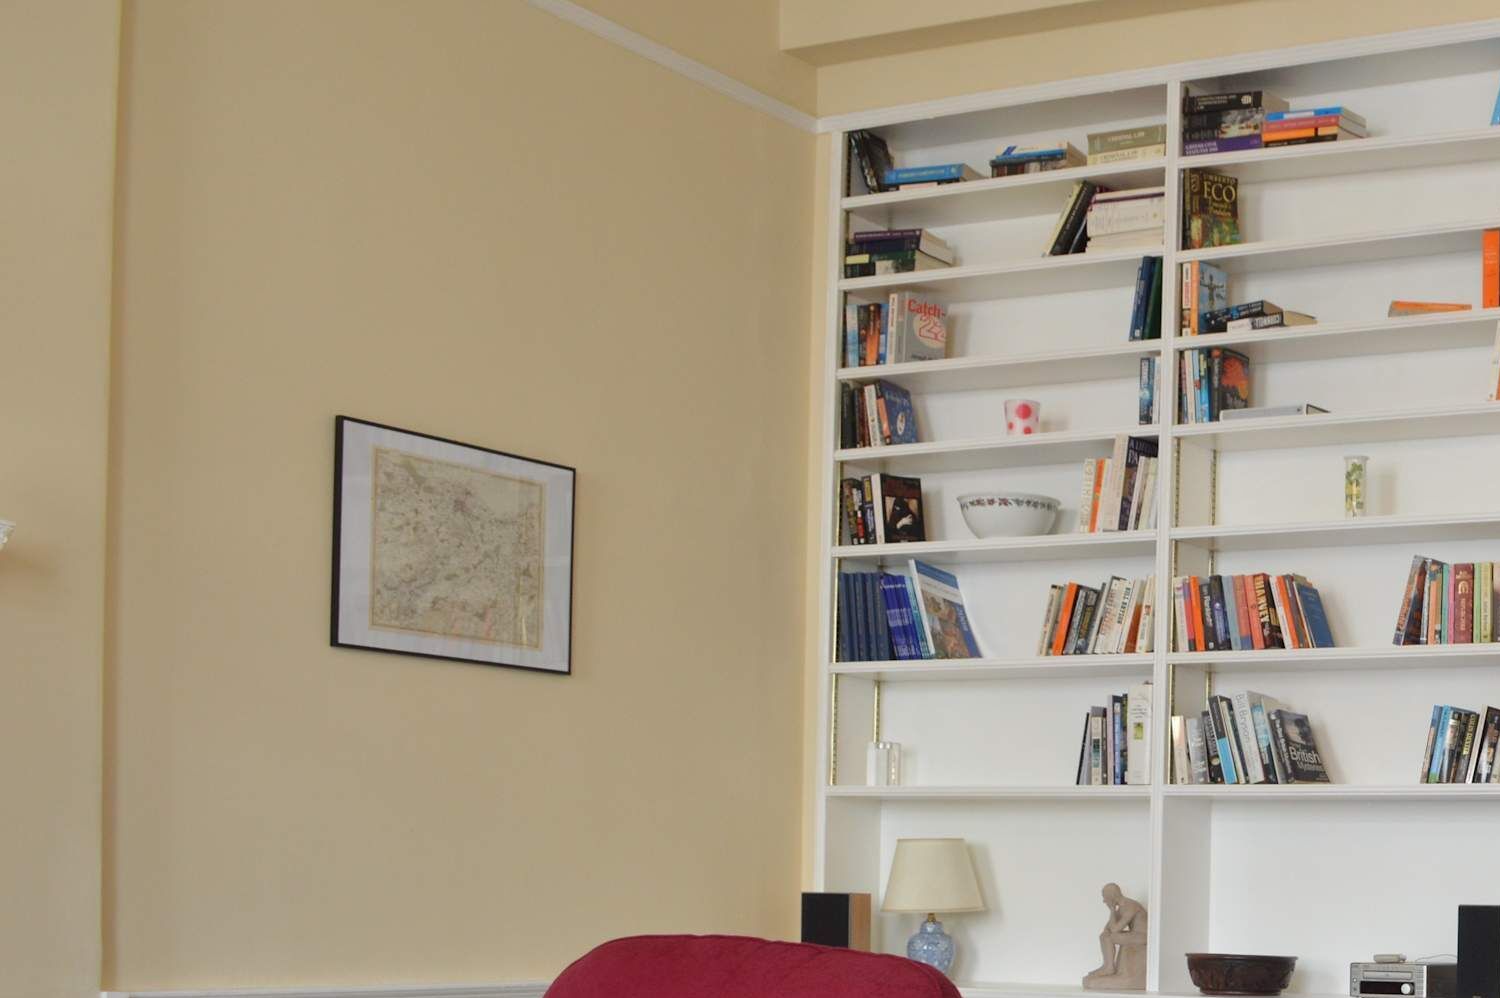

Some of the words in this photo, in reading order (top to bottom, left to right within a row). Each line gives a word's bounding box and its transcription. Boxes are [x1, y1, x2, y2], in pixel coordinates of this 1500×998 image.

[1204, 181, 1236, 202] ECO
[908, 298, 946, 319] Catch-
[1237, 710, 1251, 742] Bryson
[1290, 746, 1320, 765] British
